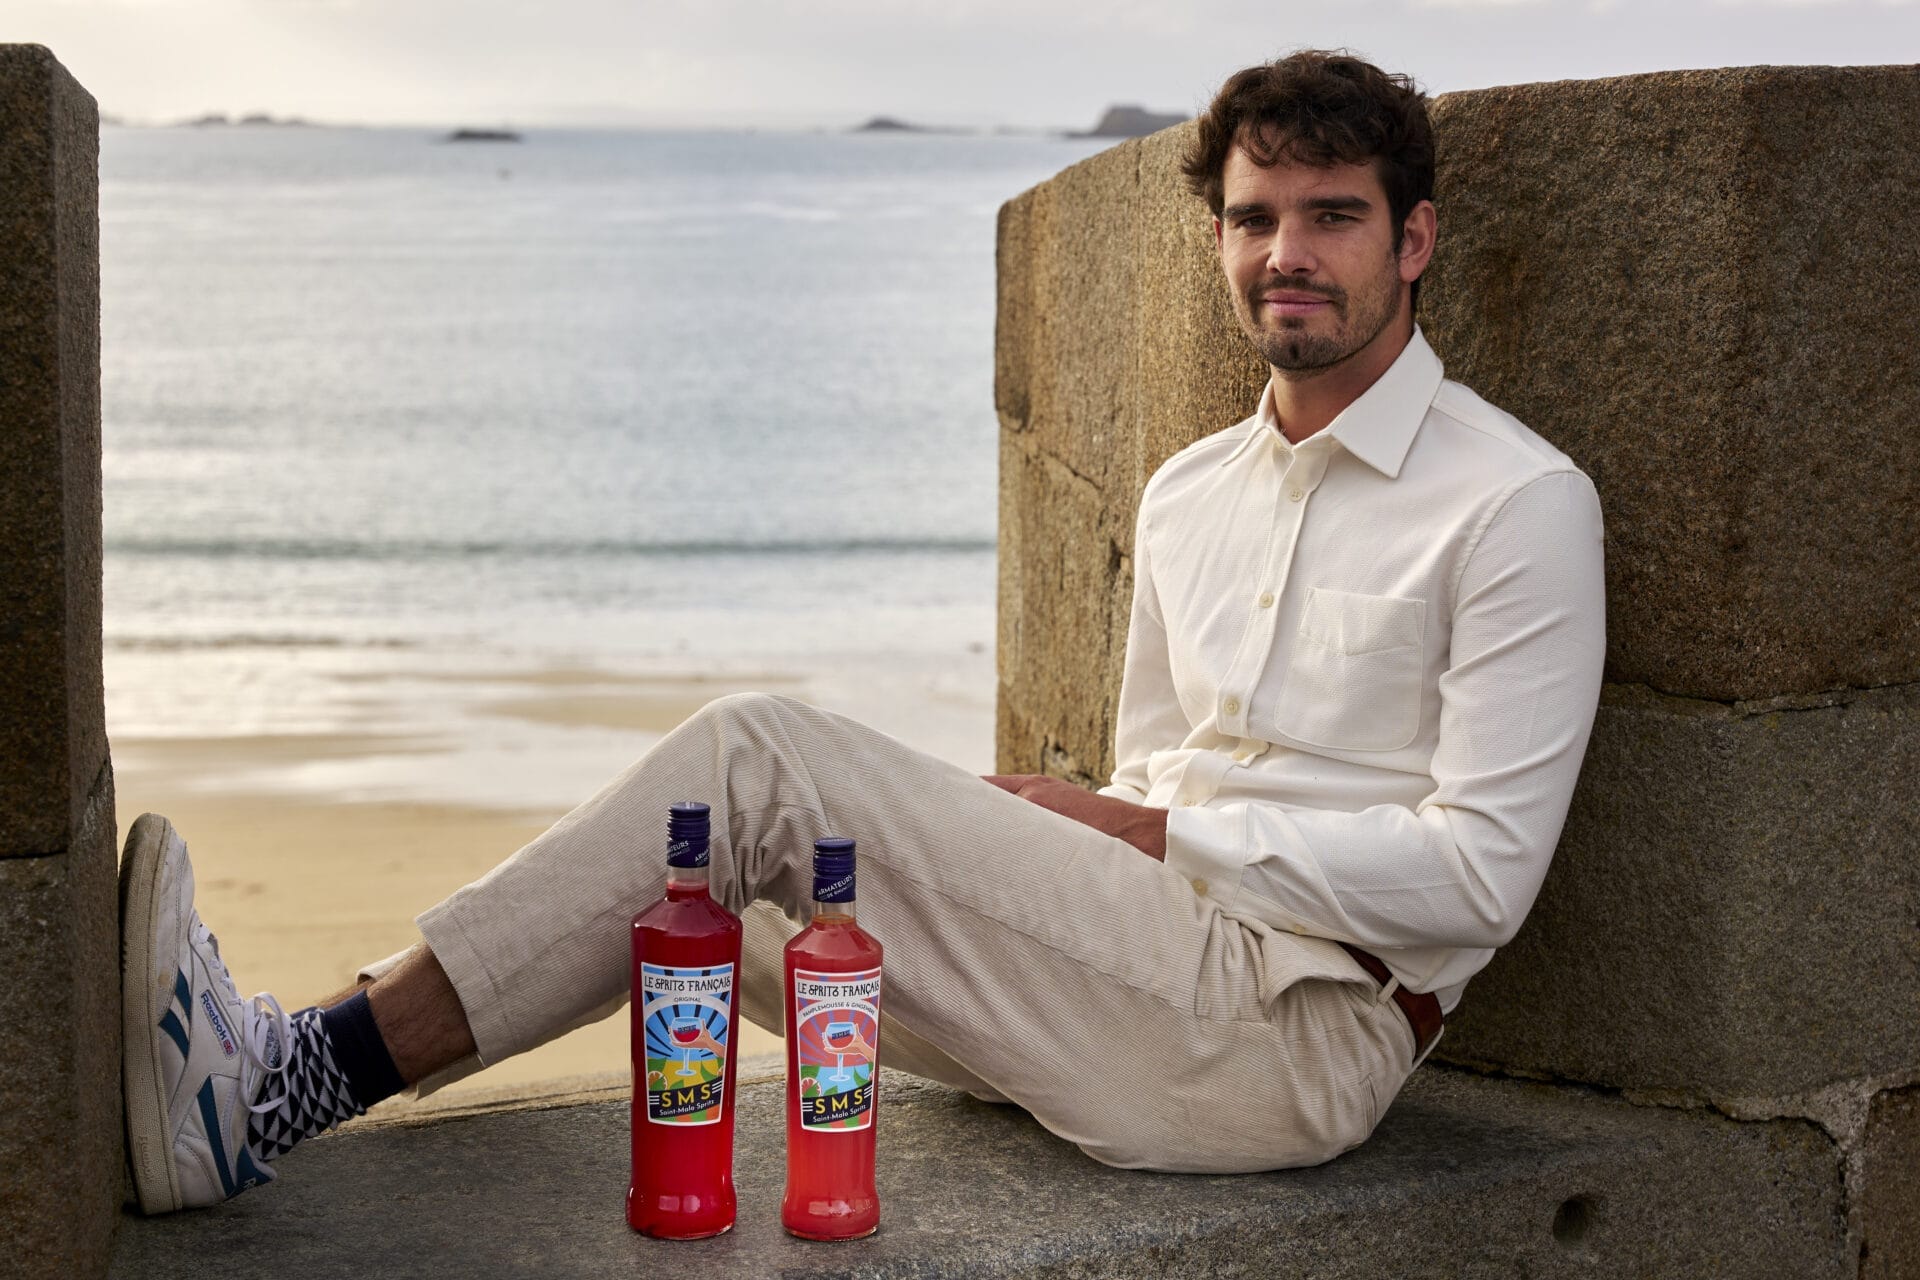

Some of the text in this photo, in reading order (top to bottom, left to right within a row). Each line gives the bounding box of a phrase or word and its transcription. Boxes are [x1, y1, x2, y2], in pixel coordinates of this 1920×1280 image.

[817, 874, 853, 896] ARMATEURS
[644, 976, 653, 988] LE
[687, 976, 731, 992] FRANÇAIS
[797, 982, 807, 995] LE
[841, 980, 879, 996] FRANÇAIS
[200, 993, 228, 1041] Reebok
[661, 1084, 711, 1108] SMS
[815, 1088, 863, 1114] SMS
[659, 1104, 695, 1117] Saint-Malo
[813, 1110, 849, 1123] Saint-Malo
